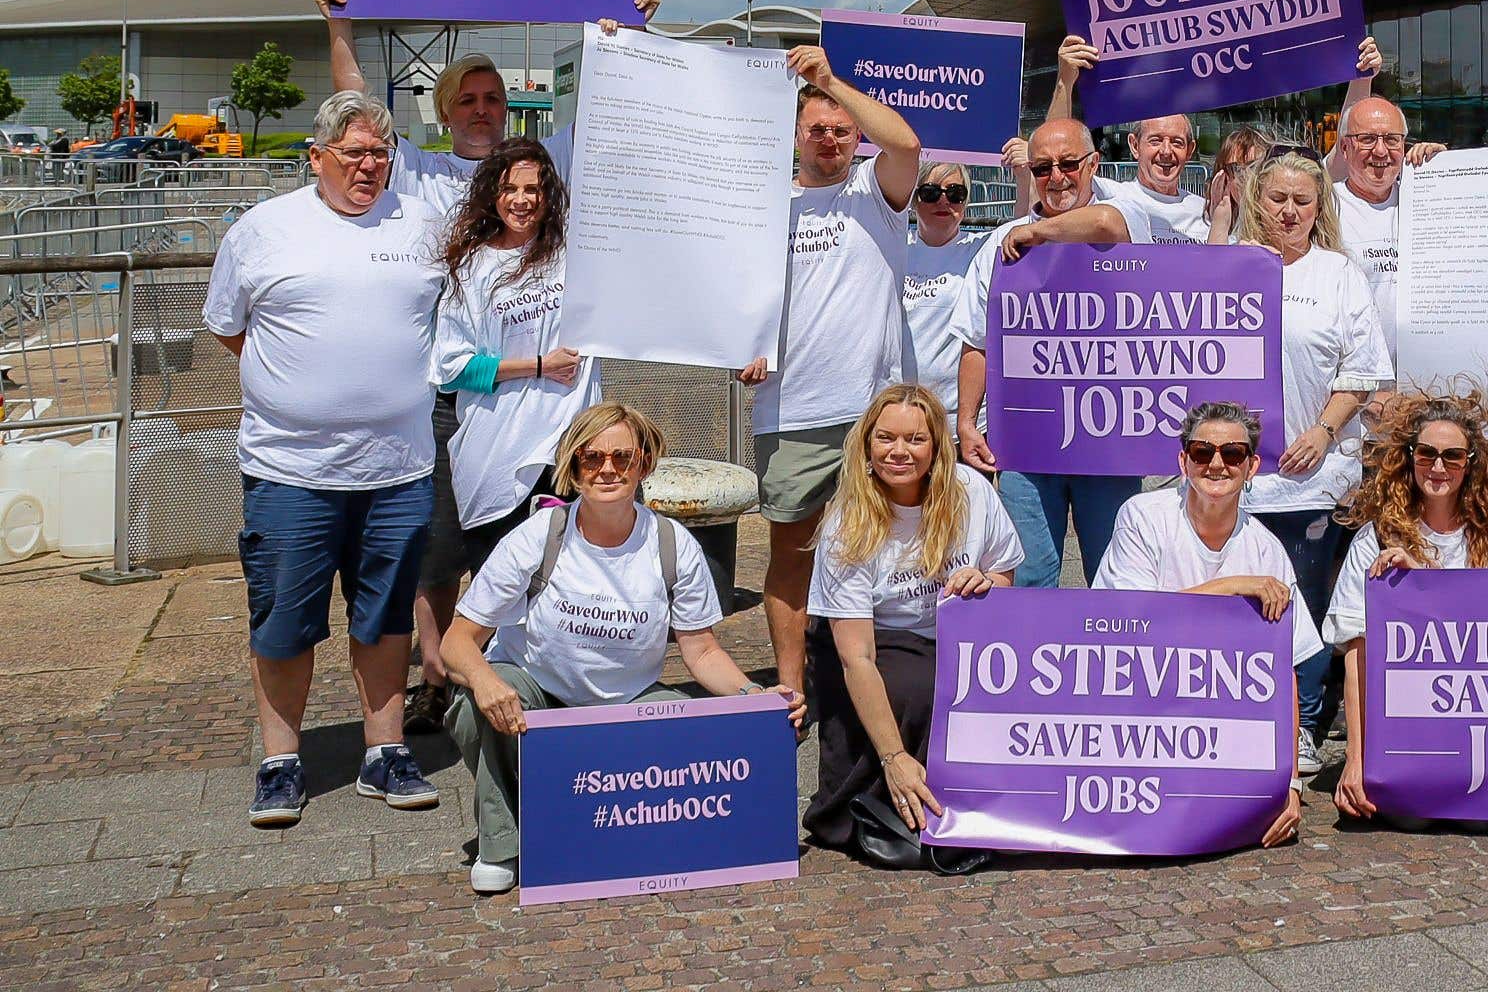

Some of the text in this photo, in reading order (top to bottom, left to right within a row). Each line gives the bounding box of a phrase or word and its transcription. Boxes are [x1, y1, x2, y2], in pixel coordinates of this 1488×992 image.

[902, 17, 940, 28] EQUITY
[1102, 15, 1202, 54] ACHUB
[746, 58, 786, 70] EQUITY
[853, 58, 985, 86] #SaveOurWNO
[1190, 44, 1253, 78] OCC
[866, 87, 969, 112] #AchubOCC
[371, 252, 418, 263] EQUITY
[1093, 259, 1148, 272] EQUITY
[1001, 292, 1264, 331] DAVID DAVIES
[1032, 339, 1227, 376] SAVE WNO
[1060, 385, 1189, 450] JOBS
[553, 598, 649, 624] #SaveOurWNO
[556, 618, 637, 641] #AchubOCC
[1084, 618, 1151, 634] EQUITY
[951, 641, 1276, 707] JO STEVENS
[637, 703, 687, 716] EQUITY
[1008, 722, 1219, 760] SAVE WNO!
[573, 758, 750, 794] #SaveOurWNO
[593, 793, 732, 828] #AchubOCC
[1062, 775, 1161, 823] JOBS
[638, 876, 689, 891] EQUITY
